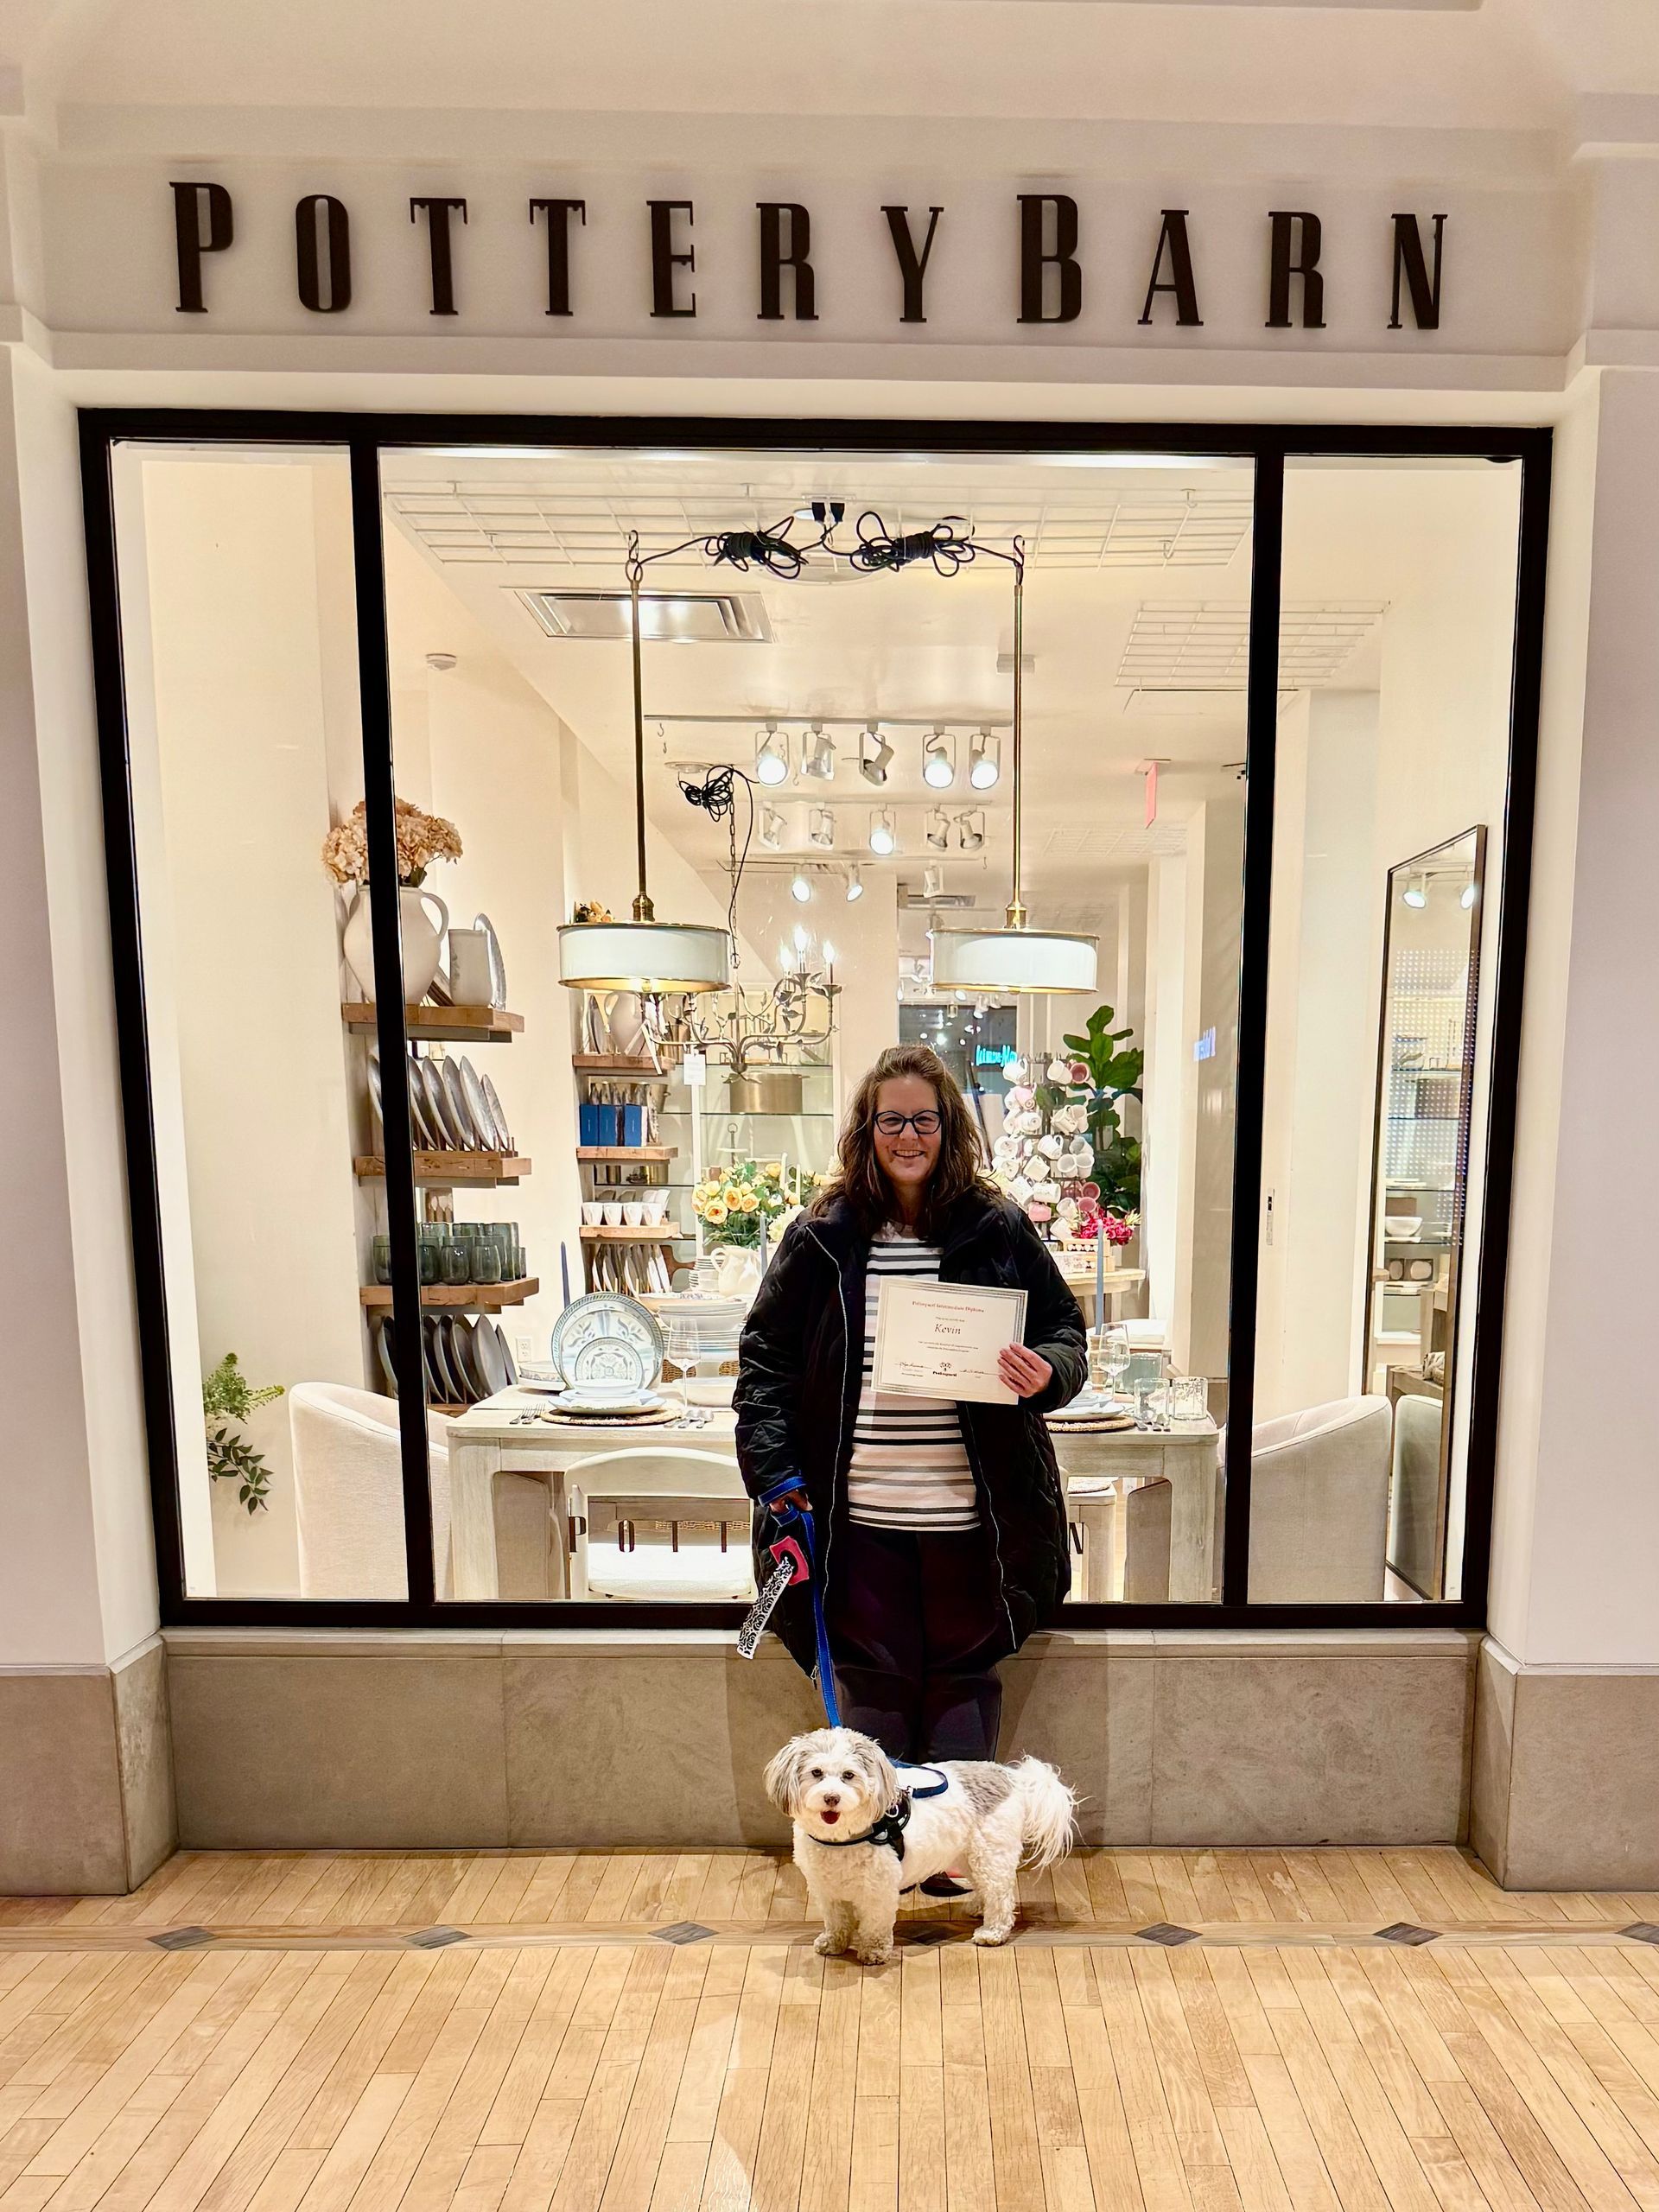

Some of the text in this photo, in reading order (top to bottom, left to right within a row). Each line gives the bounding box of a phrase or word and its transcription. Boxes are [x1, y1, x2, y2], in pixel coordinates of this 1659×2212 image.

[168, 181, 1448, 330] POTTERY BARN
[934, 1323, 961, 1335] Kevin
